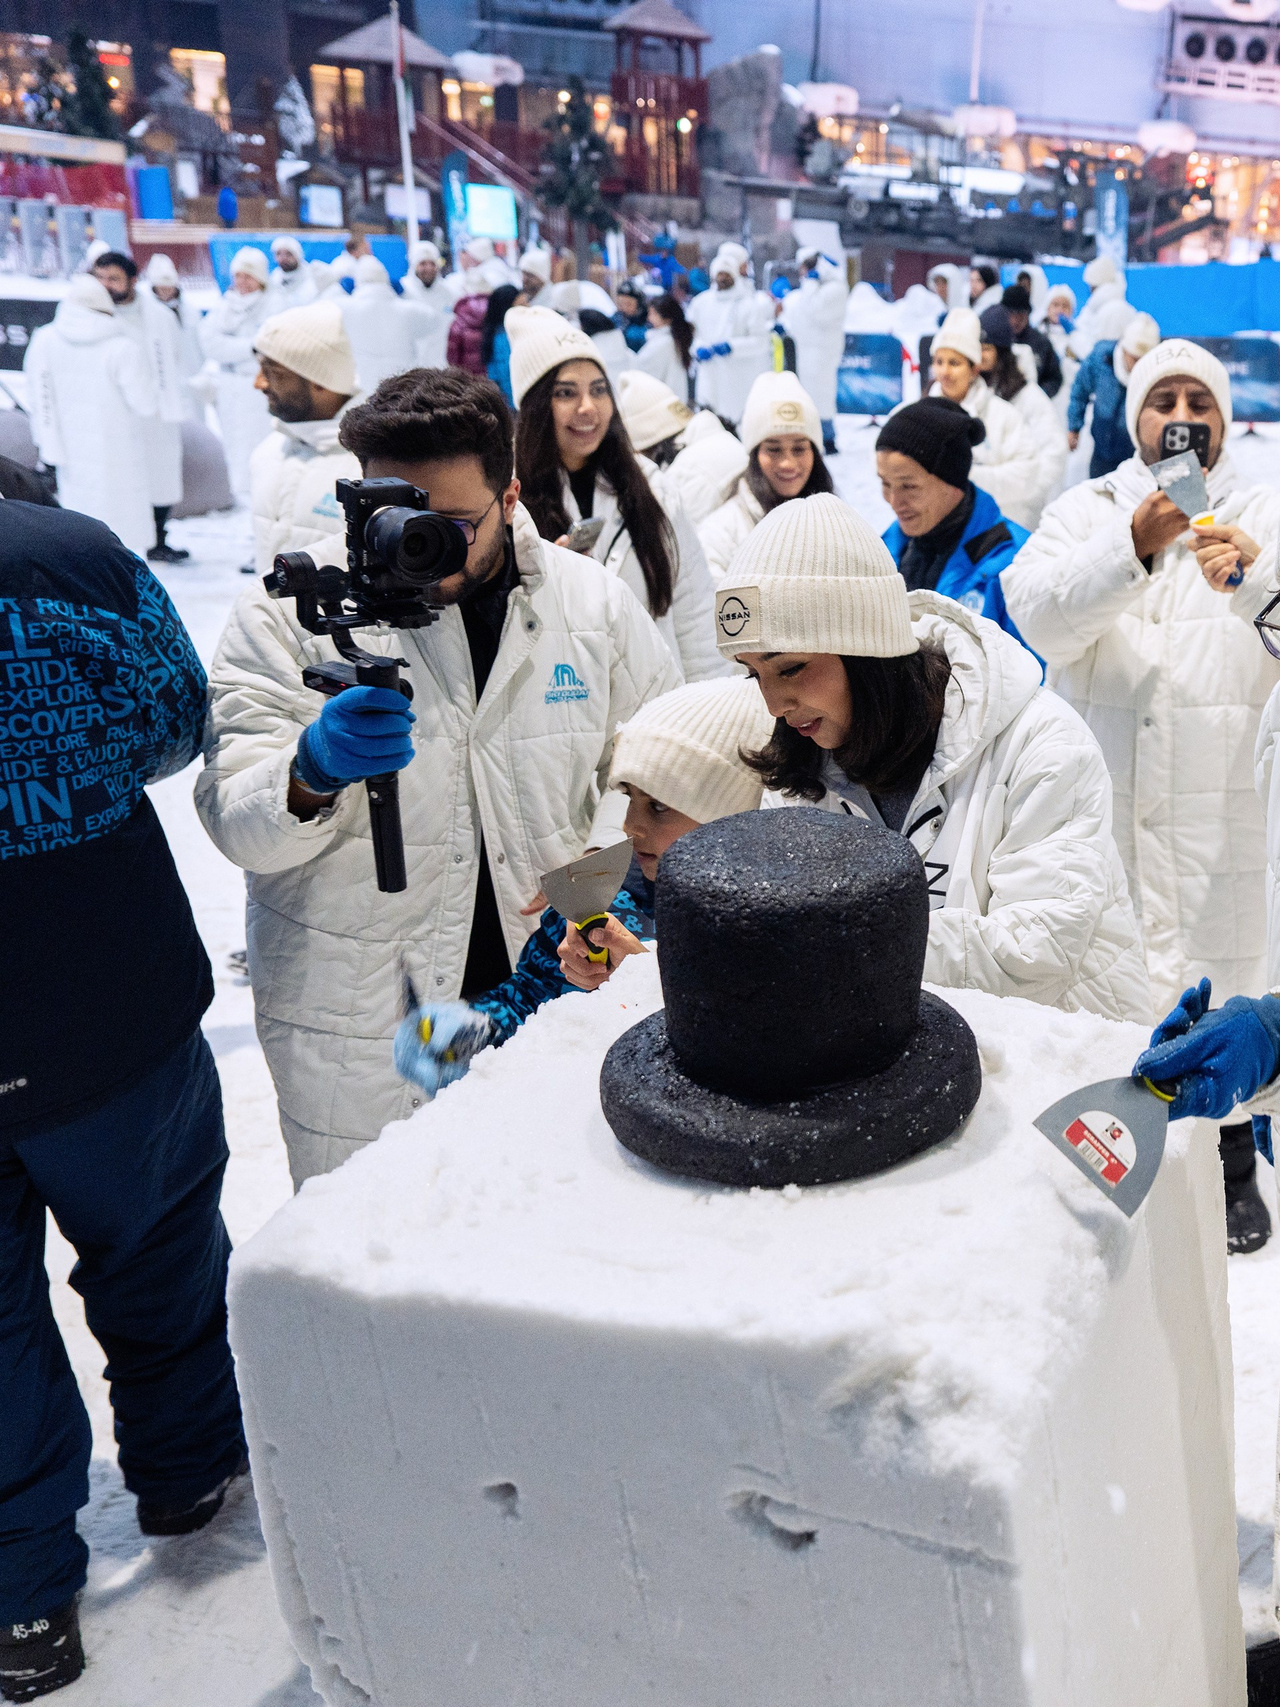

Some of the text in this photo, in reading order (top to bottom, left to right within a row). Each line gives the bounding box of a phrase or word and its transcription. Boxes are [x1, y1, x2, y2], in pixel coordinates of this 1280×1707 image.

[36, 598, 97, 621] ROLL
[718, 610, 751, 622] NISSAN
[27, 621, 115, 645] EXPLORE
[57, 638, 105, 659] RIDE
[6, 657, 82, 688] RIDE
[1, 730, 90, 758] EXPLORE
[0, 740, 132, 781] IDE & ENJOY
[23, 821, 73, 840] SPIN
